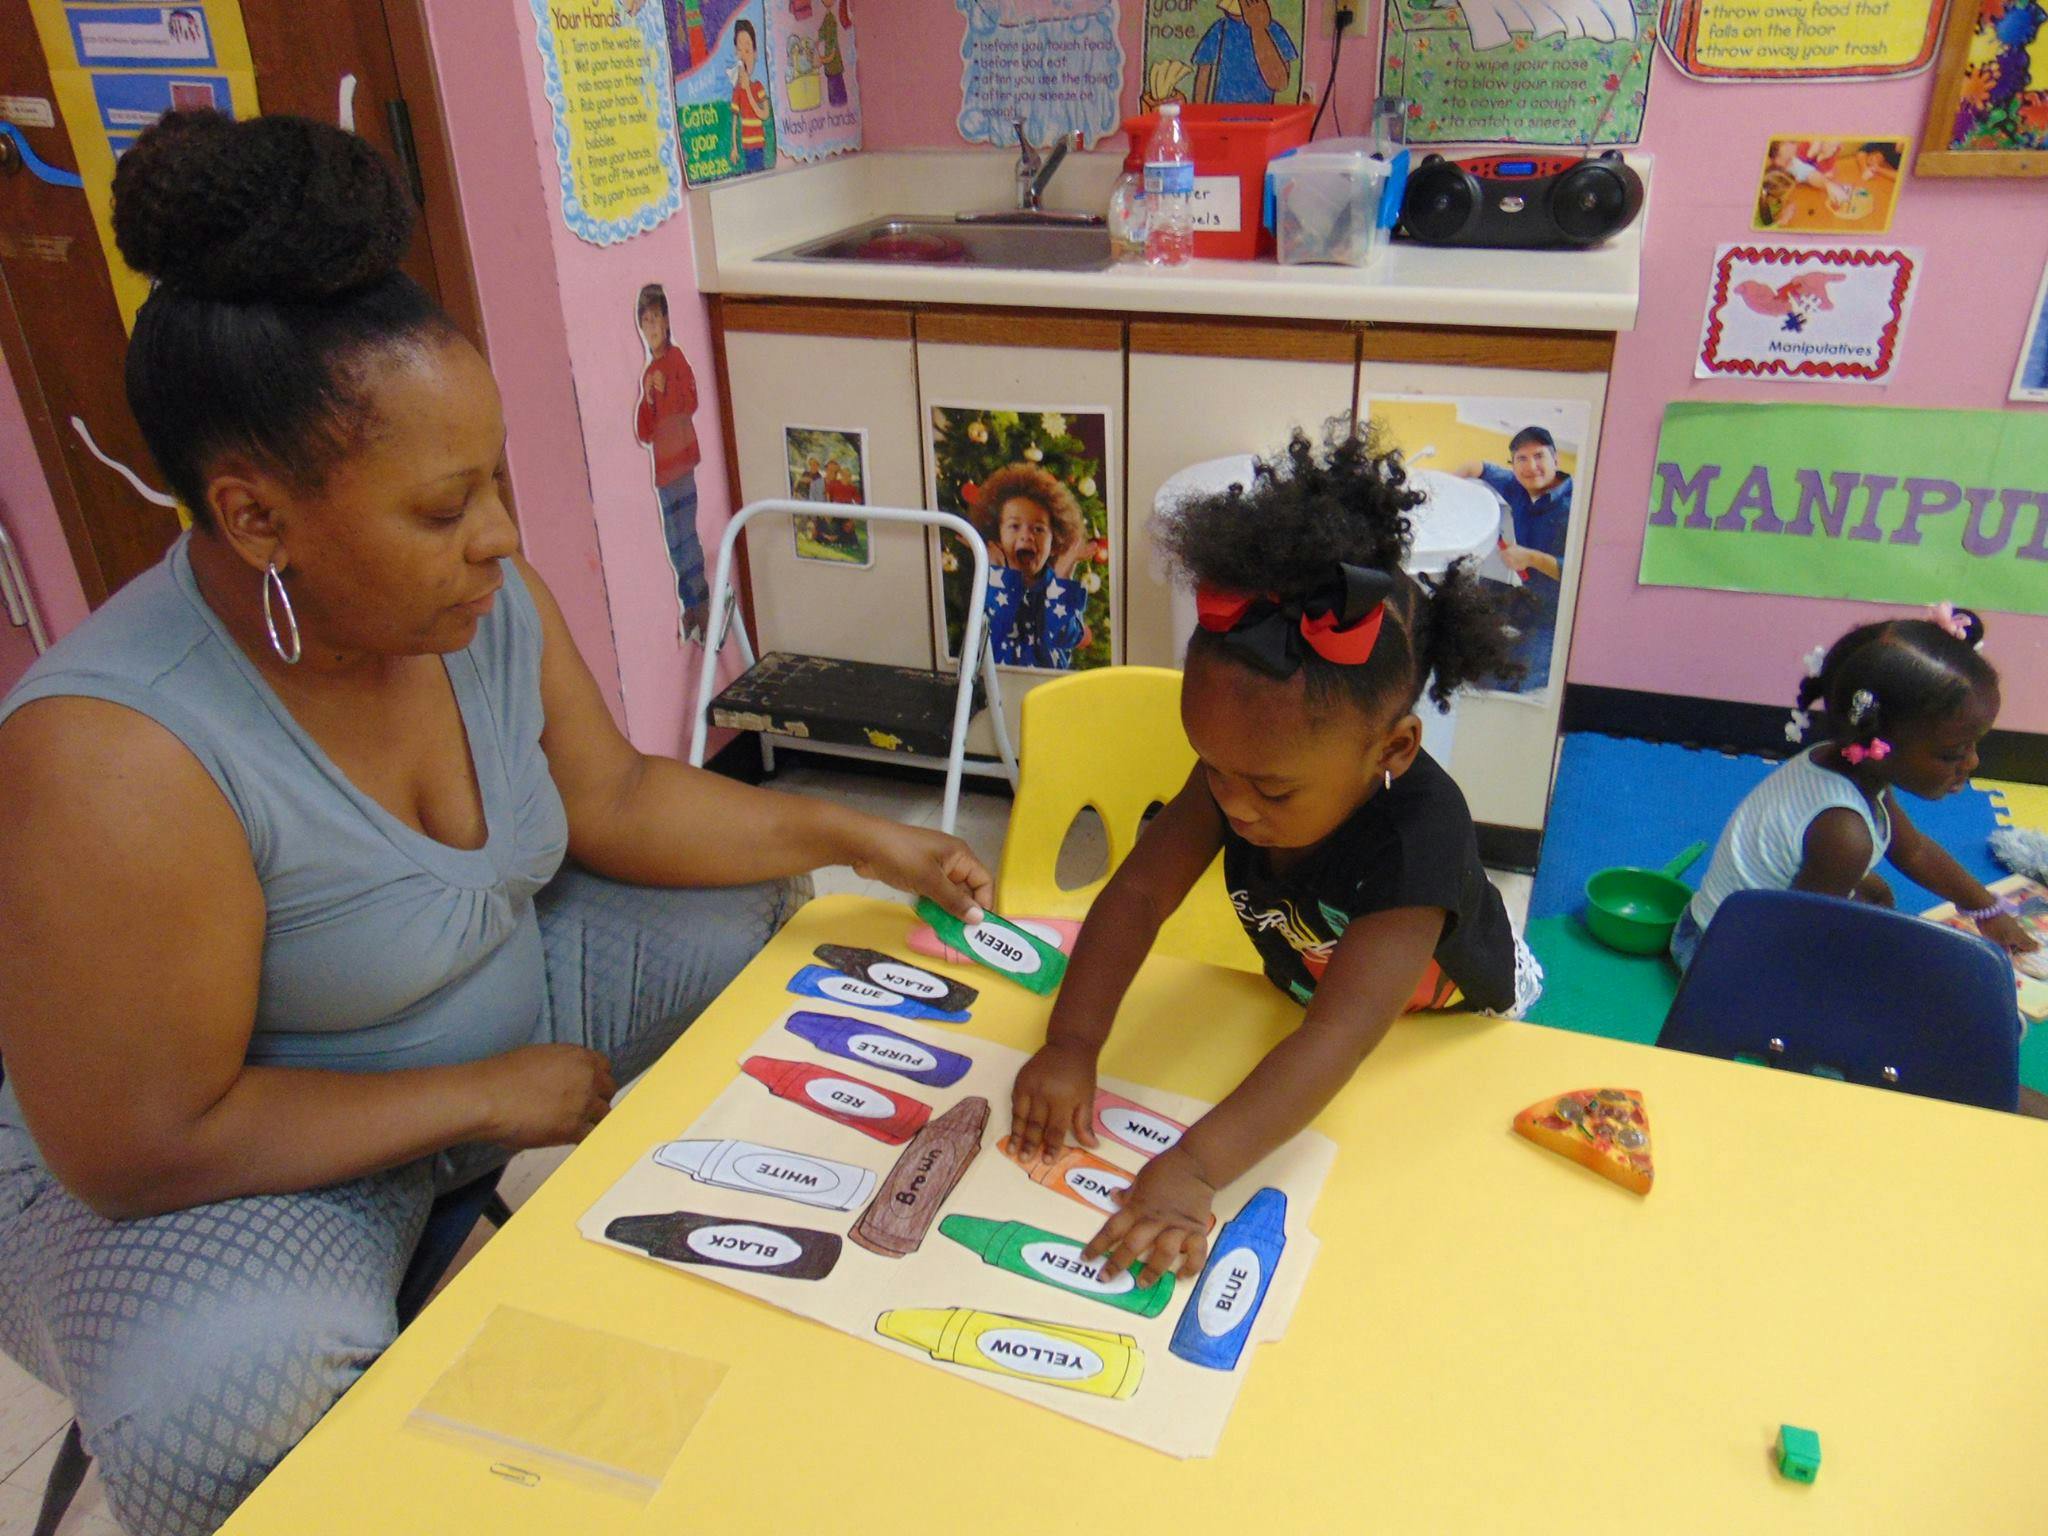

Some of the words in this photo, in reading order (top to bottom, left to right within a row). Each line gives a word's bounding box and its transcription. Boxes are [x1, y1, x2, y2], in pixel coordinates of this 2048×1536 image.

[551, 7, 582, 30] Your
[582, 7, 622, 29] Hands
[1152, 0, 1198, 18] your
[1713, 5, 1761, 19] throw
[1764, 6, 1808, 20] away
[1812, 0, 1851, 17] food
[1855, 0, 1890, 16] that
[1709, 22, 1740, 39] falls
[1743, 26, 1763, 38] on
[1767, 23, 1793, 38] the
[1796, 20, 1837, 37] floor
[980, 38, 1019, 50] before
[1022, 42, 1043, 55] you
[1048, 39, 1081, 50] touch
[1706, 43, 1753, 59] throw
[1757, 46, 1799, 61] away
[1801, 45, 1840, 60] your
[1845, 40, 1889, 56] trash
[980, 56, 1020, 69] before
[1022, 58, 1044, 71] you
[1046, 57, 1067, 69] eat
[1455, 57, 1471, 71] to
[1475, 59, 1510, 74] wipe
[1513, 60, 1549, 74] your
[1552, 58, 1589, 71] nose
[981, 73, 1012, 85] after
[1014, 75, 1035, 88] you
[1062, 72, 1081, 84] the
[1453, 76, 1468, 90] to
[1472, 76, 1508, 90] blow
[1512, 79, 1548, 94] your
[1551, 79, 1588, 90] nose
[981, 89, 1012, 102] after
[1014, 91, 1036, 104] you
[1040, 91, 1077, 102] sneeze
[1452, 95, 1467, 109] to
[1470, 98, 1512, 109] cover
[1517, 98, 1526, 109] a
[1530, 94, 1577, 113] cough
[681, 103, 719, 130] Catch
[782, 114, 807, 135] Wash
[807, 118, 826, 138] your
[1450, 114, 1465, 127] to
[1468, 116, 1510, 128] catch
[1514, 118, 1523, 128] a
[1528, 117, 1577, 129] sneeze
[691, 133, 719, 159] your
[1768, 339, 1873, 357] Manipulatives
[974, 929, 1024, 962] GREEN
[840, 982, 885, 999] BLUE
[883, 973, 935, 993] BLACK
[857, 1040, 924, 1067] PURPLE
[830, 1090, 866, 1109] RED
[1125, 1120, 1171, 1145] PINK
[756, 1162, 819, 1188] WHITE
[895, 1148, 943, 1206] Brown
[1071, 1173, 1112, 1198] NGE
[708, 1234, 780, 1258] BLACK
[1215, 1266, 1249, 1312] BLUE
[990, 1339, 1084, 1370] YELLOW
